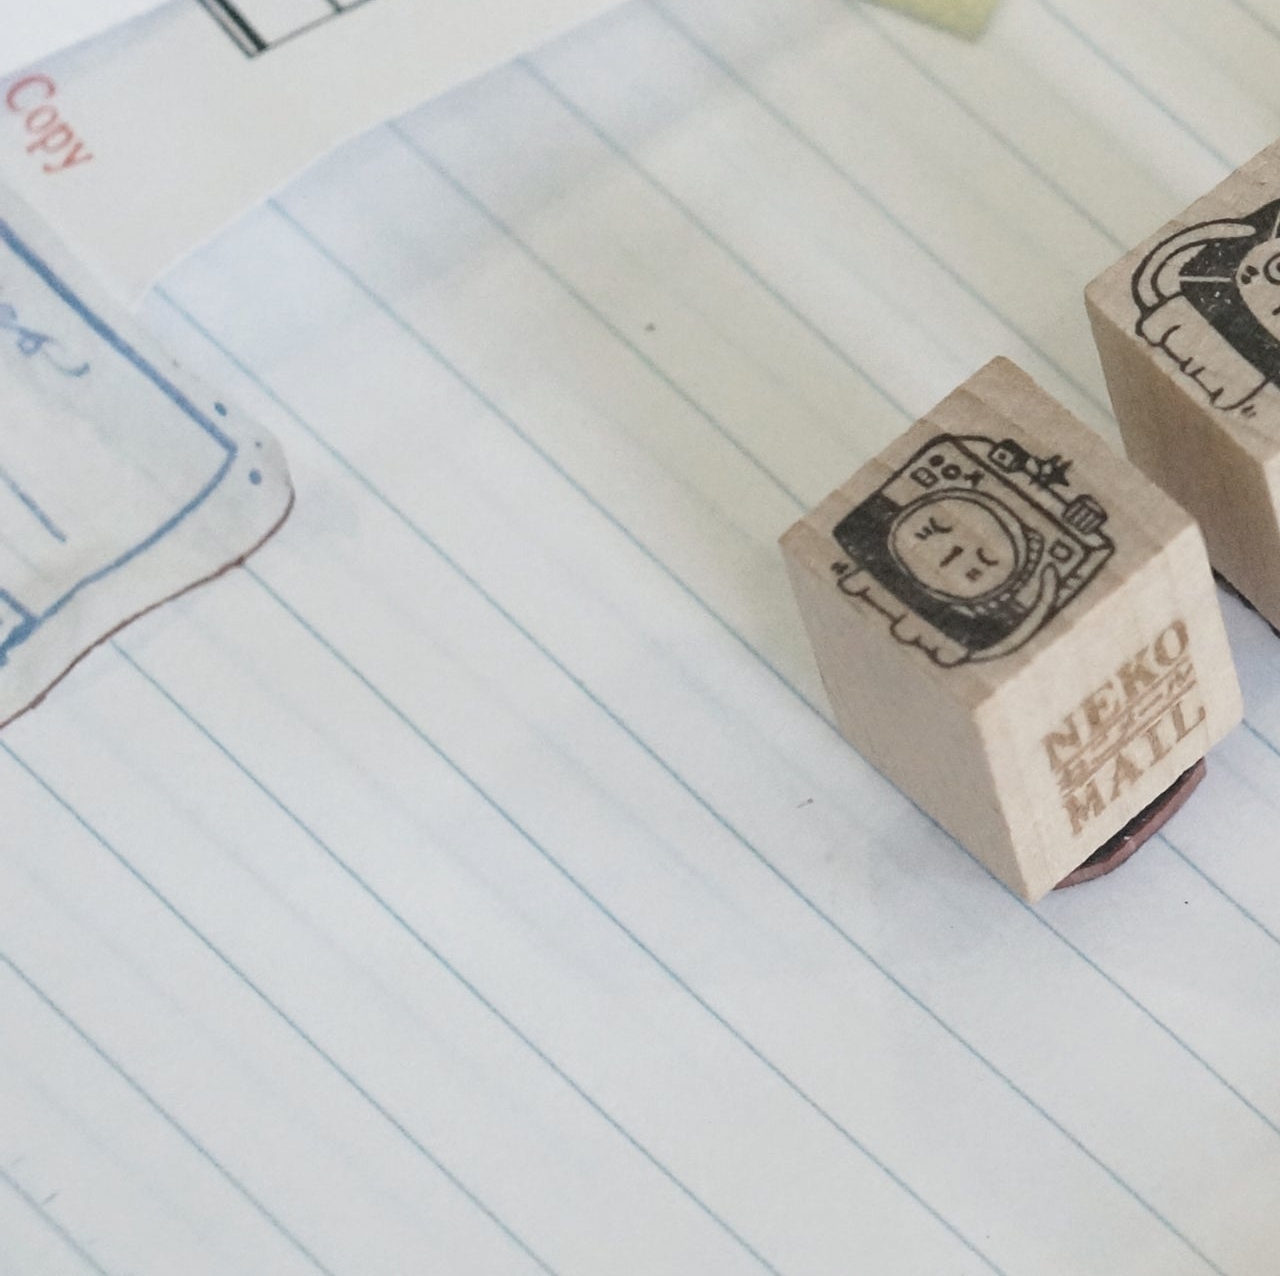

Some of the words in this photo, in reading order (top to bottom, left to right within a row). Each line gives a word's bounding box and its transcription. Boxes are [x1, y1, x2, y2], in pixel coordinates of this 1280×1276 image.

[4, 73, 93, 177] Copy
[1041, 618, 1191, 771] NEKO
[1059, 700, 1206, 836] MAIL
